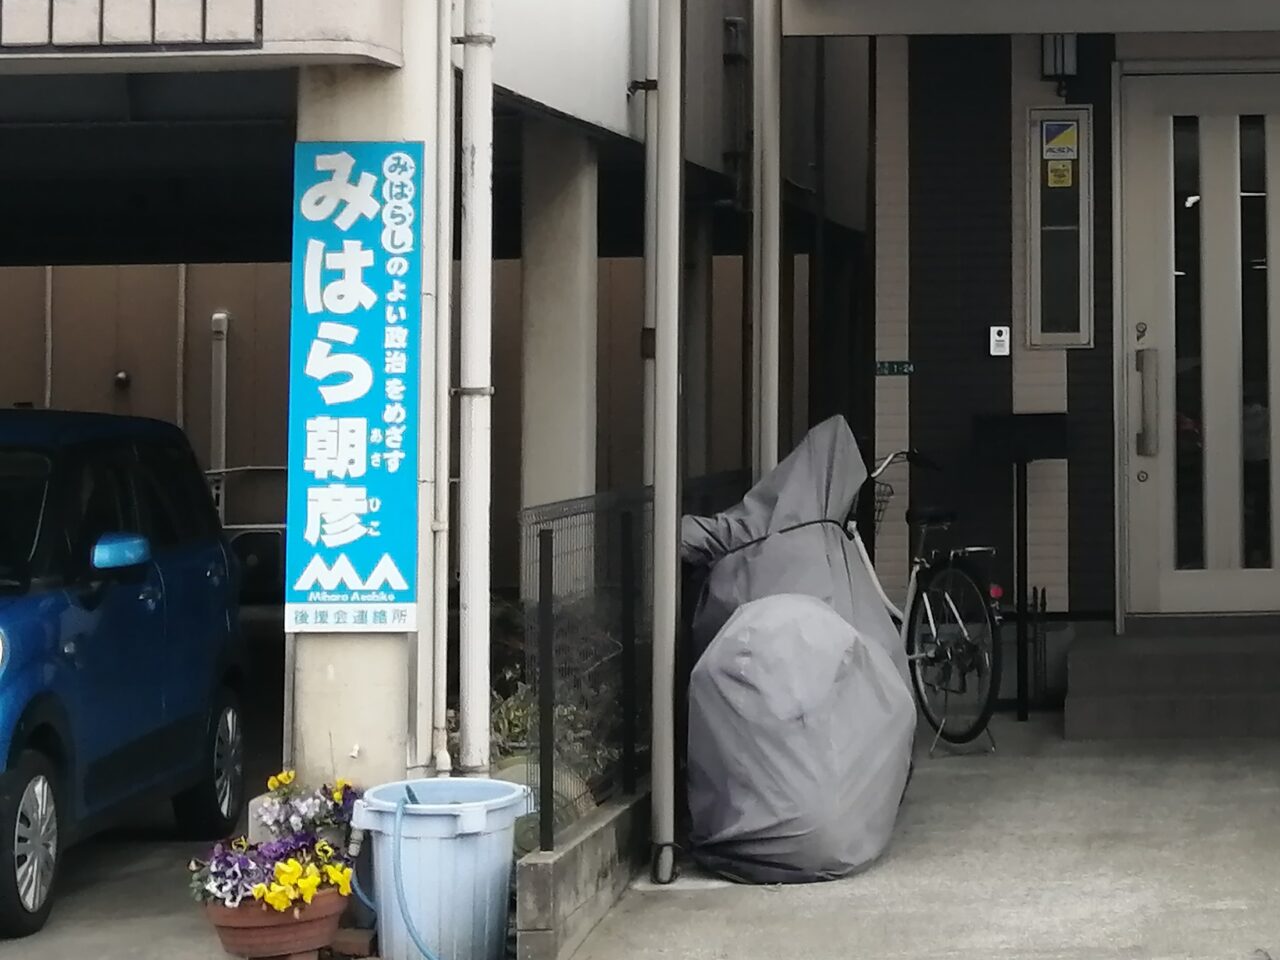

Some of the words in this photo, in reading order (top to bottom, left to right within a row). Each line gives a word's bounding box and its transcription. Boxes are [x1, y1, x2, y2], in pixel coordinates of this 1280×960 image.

[301, 151, 381, 548] みはら朝彦
[383, 155, 410, 473] みはらしのよい政治をめざす
[294, 608, 408, 625] 後援会連絡所
